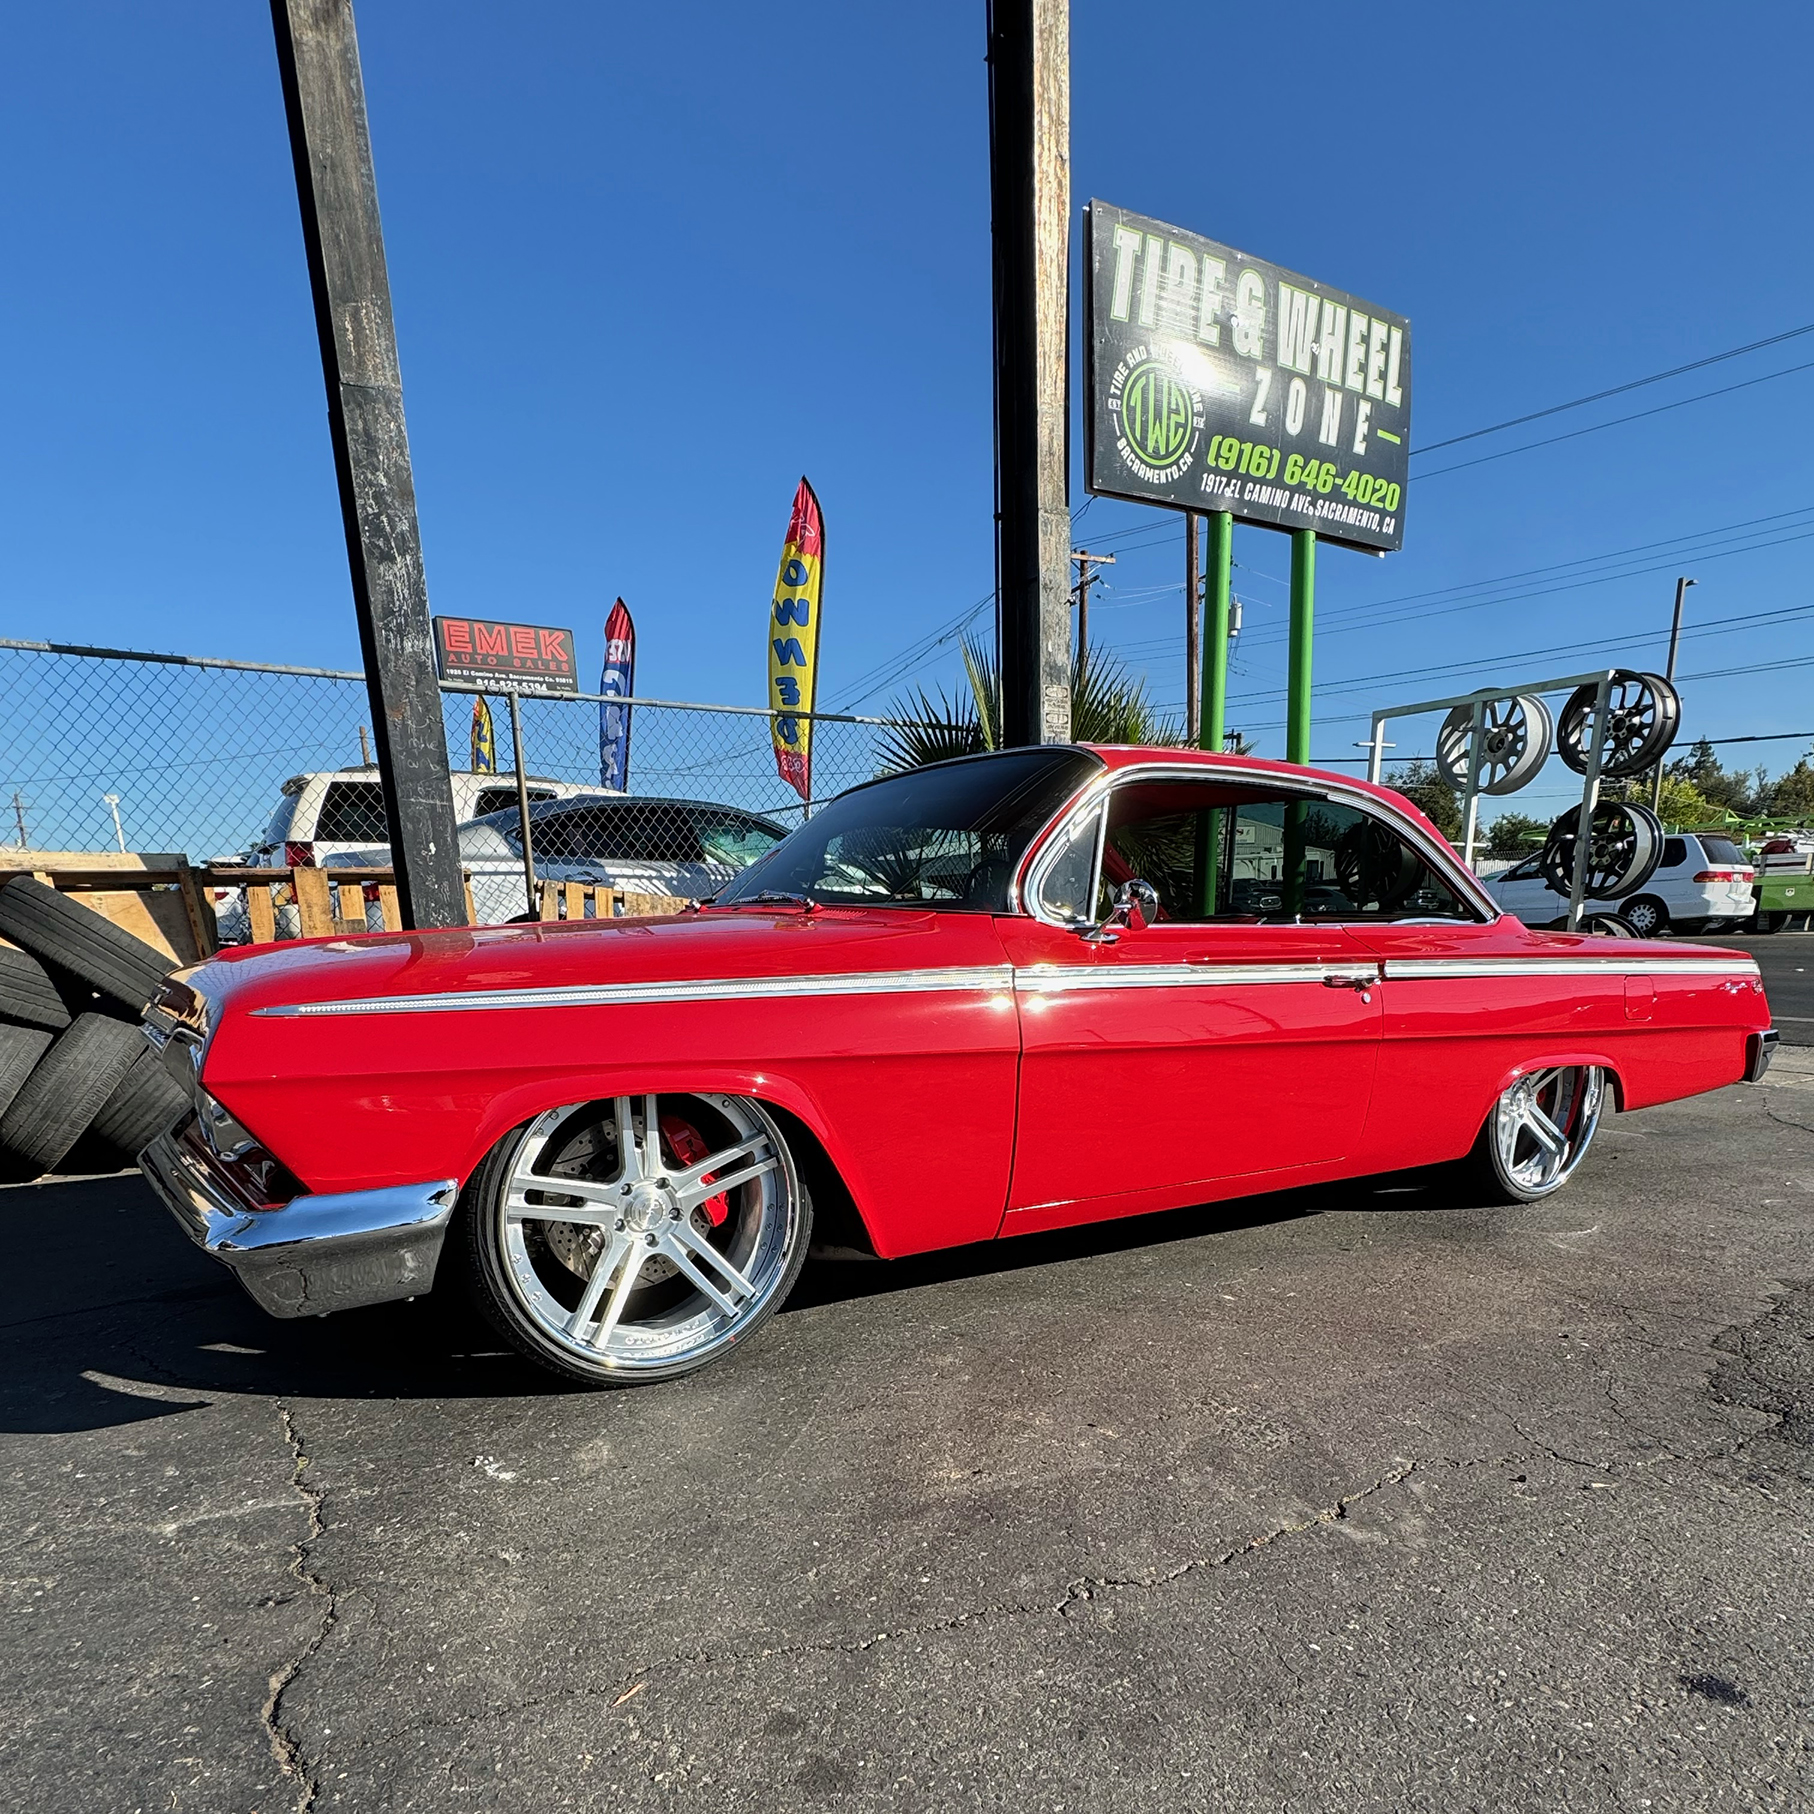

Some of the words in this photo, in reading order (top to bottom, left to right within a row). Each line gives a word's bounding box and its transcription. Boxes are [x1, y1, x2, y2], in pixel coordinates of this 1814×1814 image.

[1231, 268, 1267, 360] &
[1277, 281, 1403, 408] WHEEL
[1110, 361, 1129, 395] TIRE
[1126, 345, 1148, 368] AND
[1249, 366, 1372, 456] ZONE
[1207, 435, 1279, 480] (916)
[1284, 453, 1401, 513] 646-4020
[1227, 483, 1241, 499] EL
[1244, 486, 1289, 510] CAMINO
[1314, 497, 1381, 533] SACRAMENTO,
[1382, 517, 1396, 535] CA
[443, 620, 568, 661] EMEK
[448, 653, 497, 666] AUTO
[513, 658, 569, 672] SALES
[509, 673, 544, 682] Sacramento
